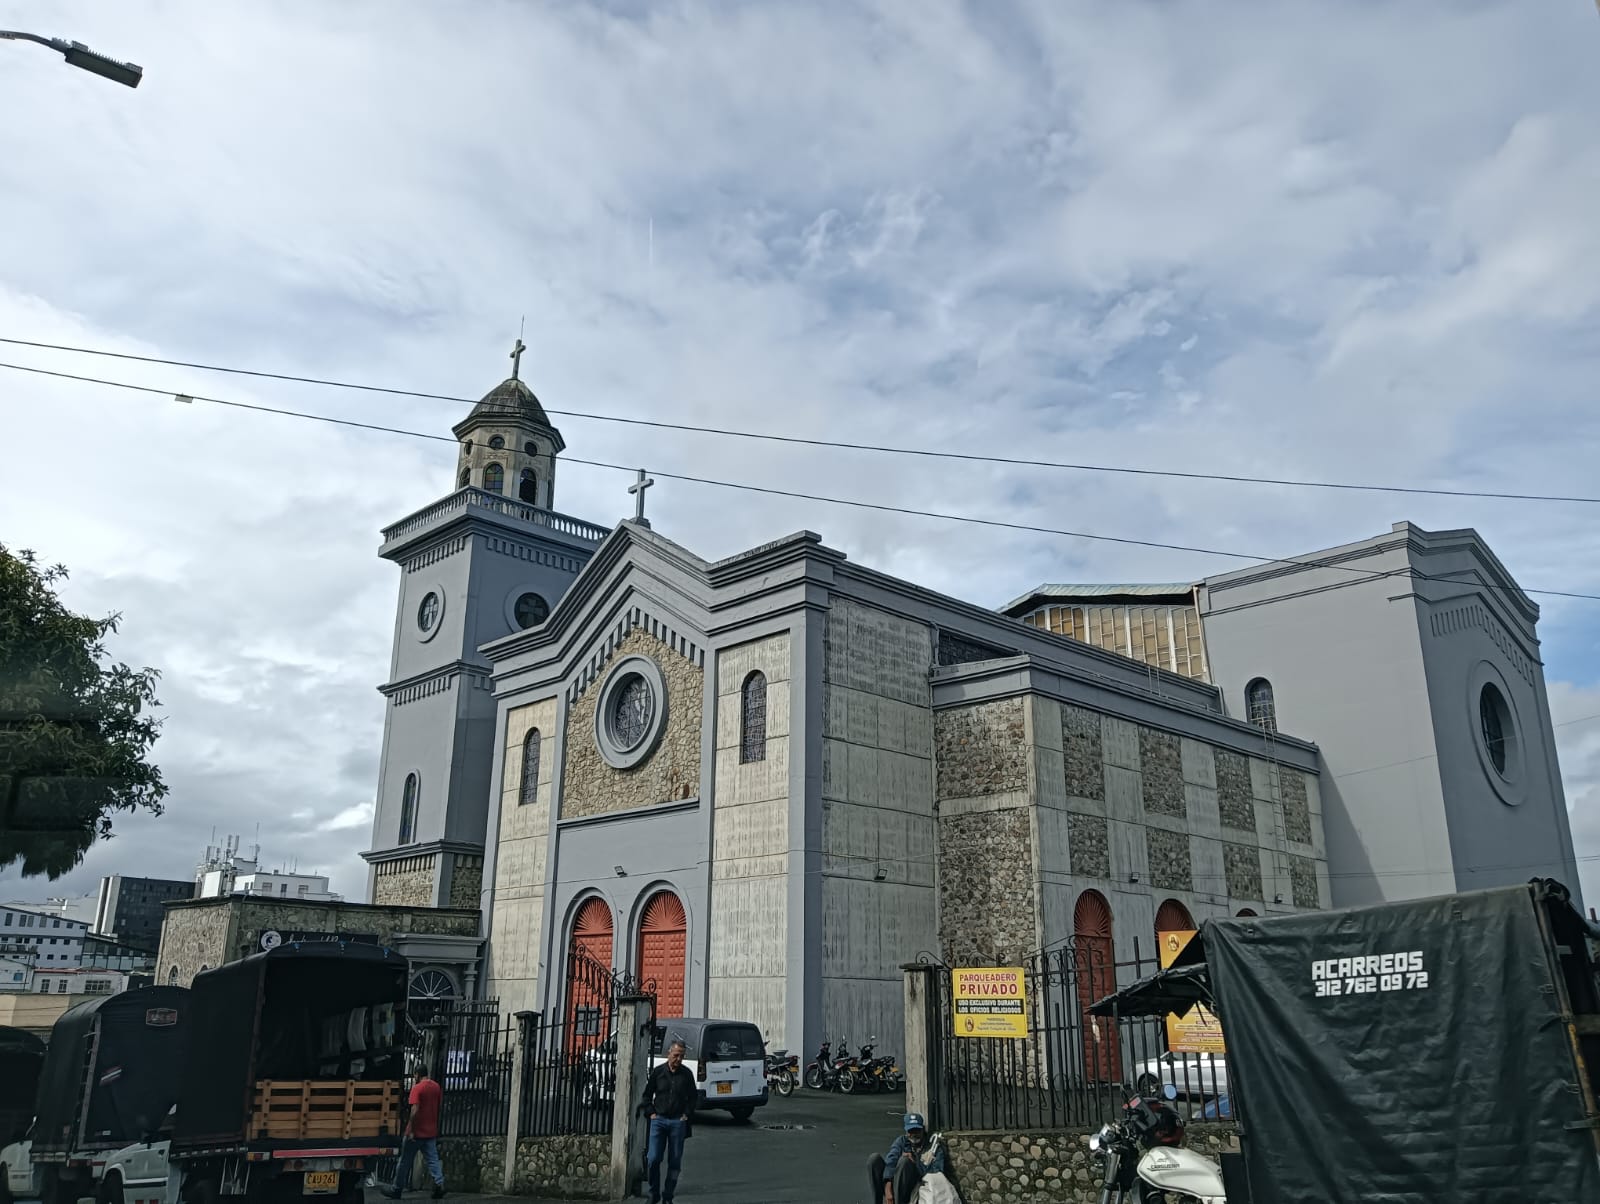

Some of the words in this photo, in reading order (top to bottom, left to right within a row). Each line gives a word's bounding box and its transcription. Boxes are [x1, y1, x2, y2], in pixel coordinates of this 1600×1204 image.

[1312, 951, 1423, 980] ACARREOS
[959, 973, 1017, 982] PARQUEADERO
[1315, 980, 1341, 997] 312
[1345, 977, 1377, 994] 762
[1380, 974, 1402, 991] 09
[1406, 971, 1428, 989] 72
[960, 983, 1018, 995] PRIVADO
